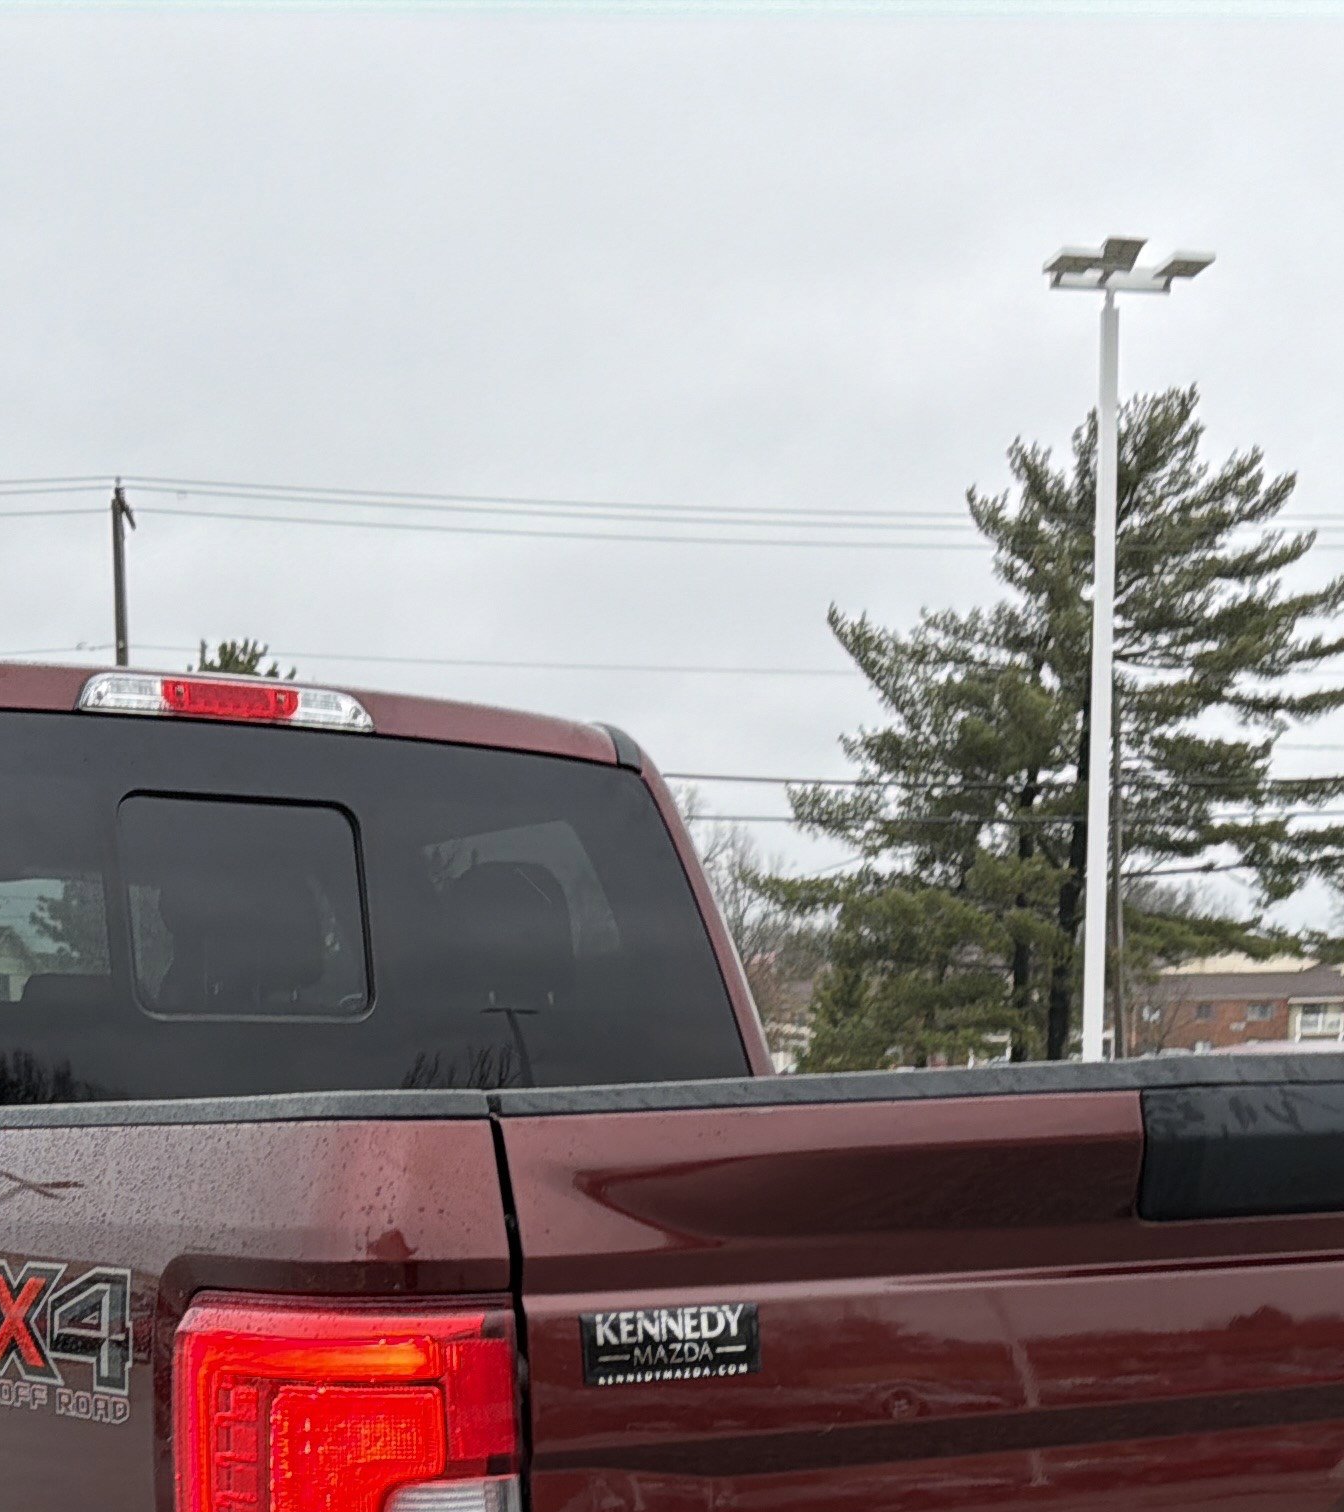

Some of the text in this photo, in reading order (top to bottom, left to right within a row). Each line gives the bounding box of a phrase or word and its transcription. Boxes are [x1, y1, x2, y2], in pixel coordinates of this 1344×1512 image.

[594, 1303, 745, 1347] KENNEDY
[633, 1341, 714, 1367] MAZDA
[56, 1388, 131, 1425] ROAD
